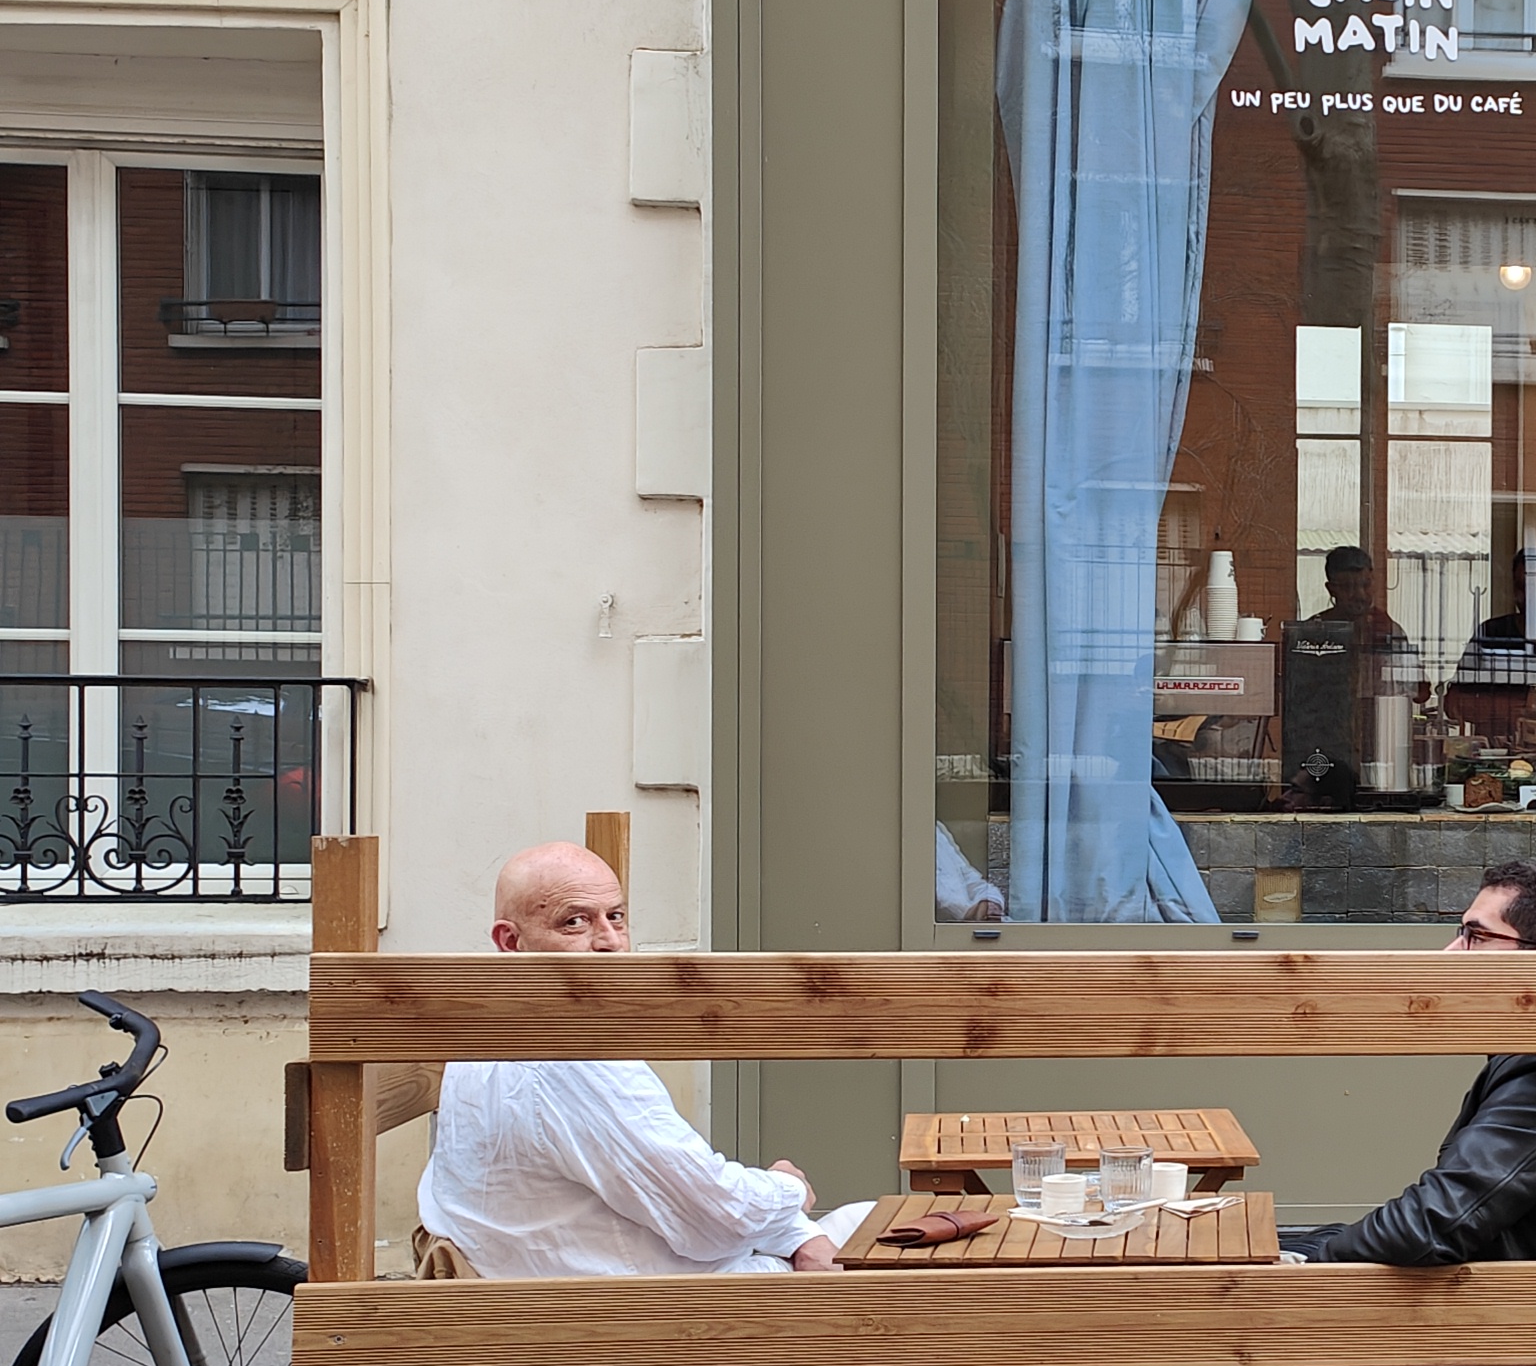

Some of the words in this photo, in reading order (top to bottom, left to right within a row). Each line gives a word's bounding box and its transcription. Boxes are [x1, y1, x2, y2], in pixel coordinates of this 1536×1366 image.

[1294, 13, 1458, 61] MATIN
[1231, 90, 1261, 107] UN
[1270, 91, 1311, 114] PEU
[1321, 92, 1373, 115] PLUS
[1382, 95, 1425, 114] QUE
[1434, 94, 1463, 112] DU
[1470, 91, 1523, 115] CAFÉ
